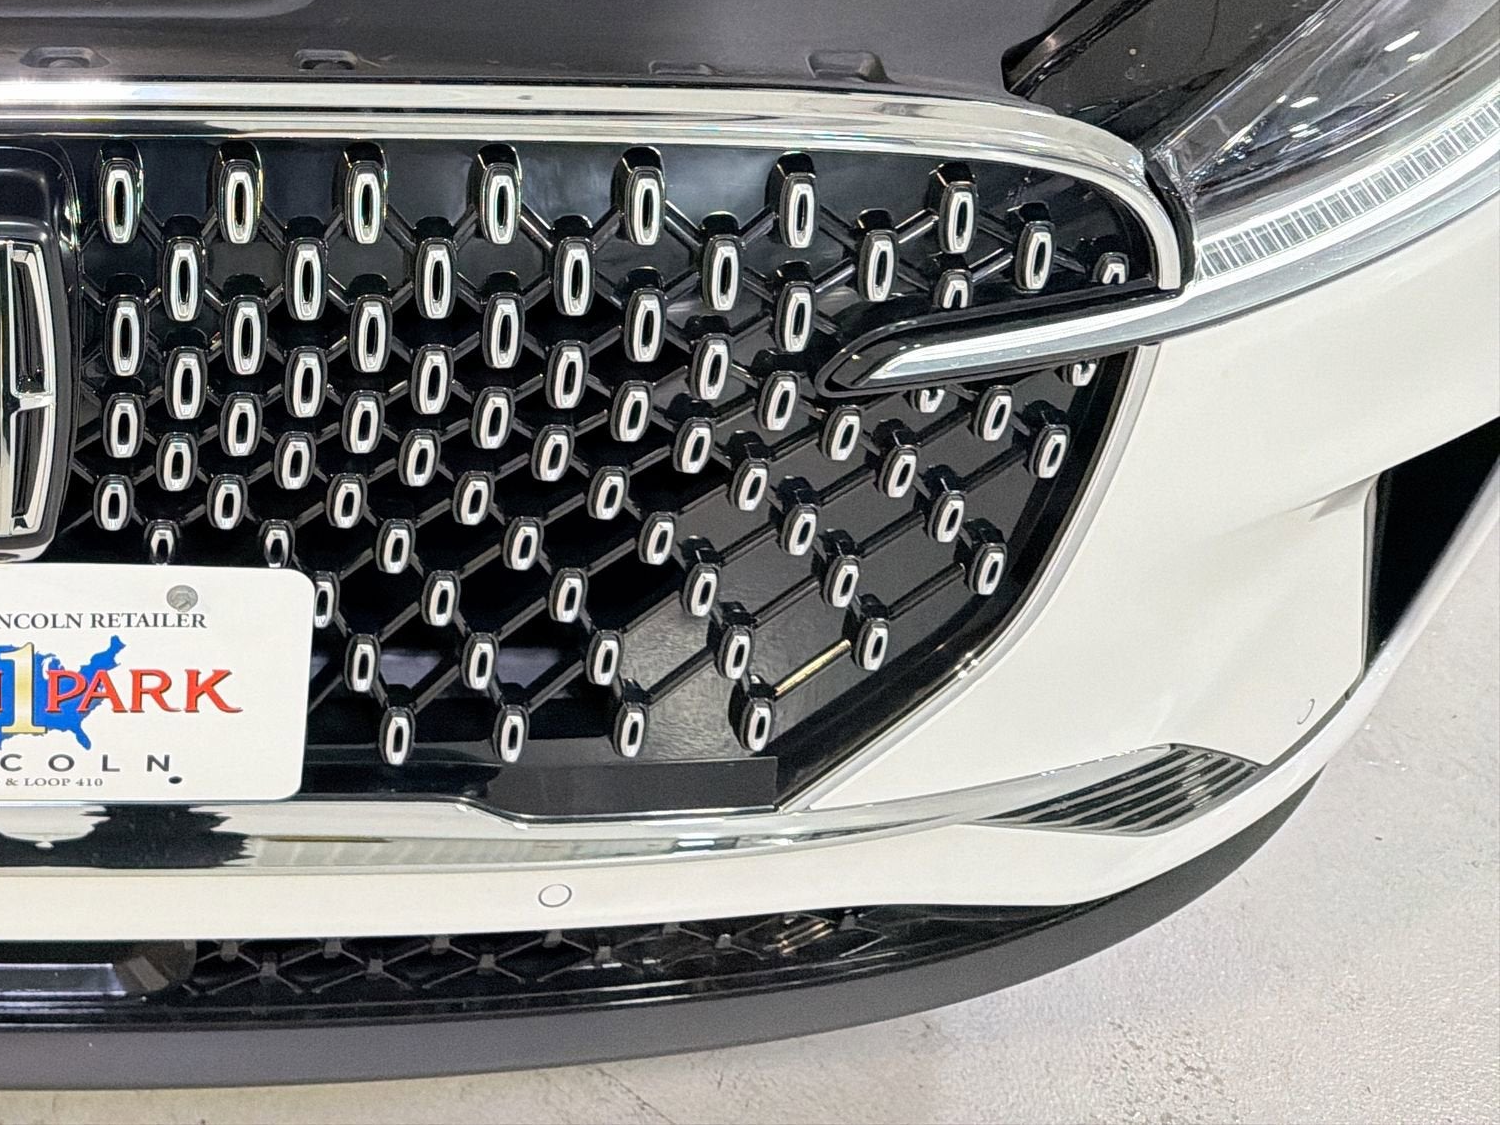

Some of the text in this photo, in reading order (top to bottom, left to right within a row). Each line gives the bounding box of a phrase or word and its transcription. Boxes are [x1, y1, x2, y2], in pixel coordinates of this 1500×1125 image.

[90, 611, 208, 629] RETAILER
[44, 668, 244, 714] PARK
[5, 777, 19, 788] &
[24, 777, 72, 788] LOOP
[75, 777, 104, 788] 410
